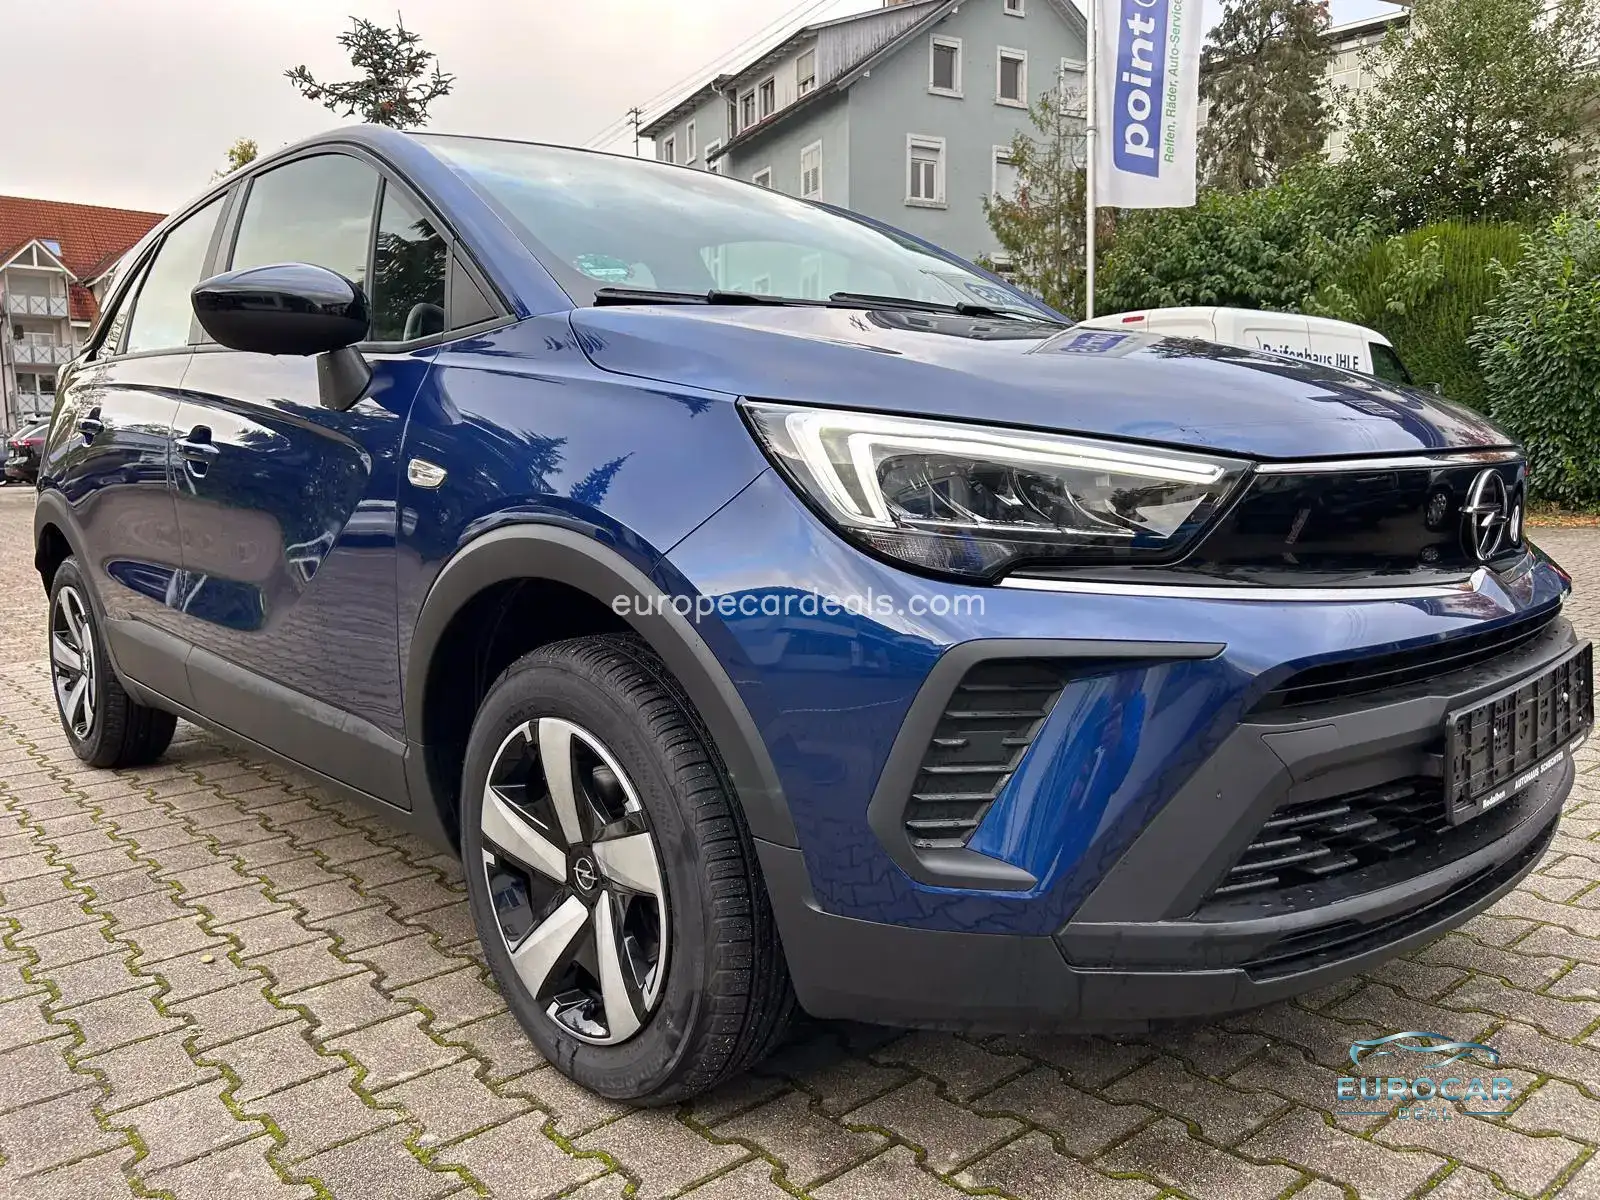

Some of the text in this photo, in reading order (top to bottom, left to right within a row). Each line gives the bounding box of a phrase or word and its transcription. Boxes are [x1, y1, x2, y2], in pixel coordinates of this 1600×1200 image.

[1122, 12, 1155, 159] point
[1165, 80, 1179, 118] Räder,
[1163, 120, 1177, 163] Reifen,
[1263, 343, 1359, 371] Rifnhaus IHLE
[1514, 767, 1540, 790] AUTOHAUS
